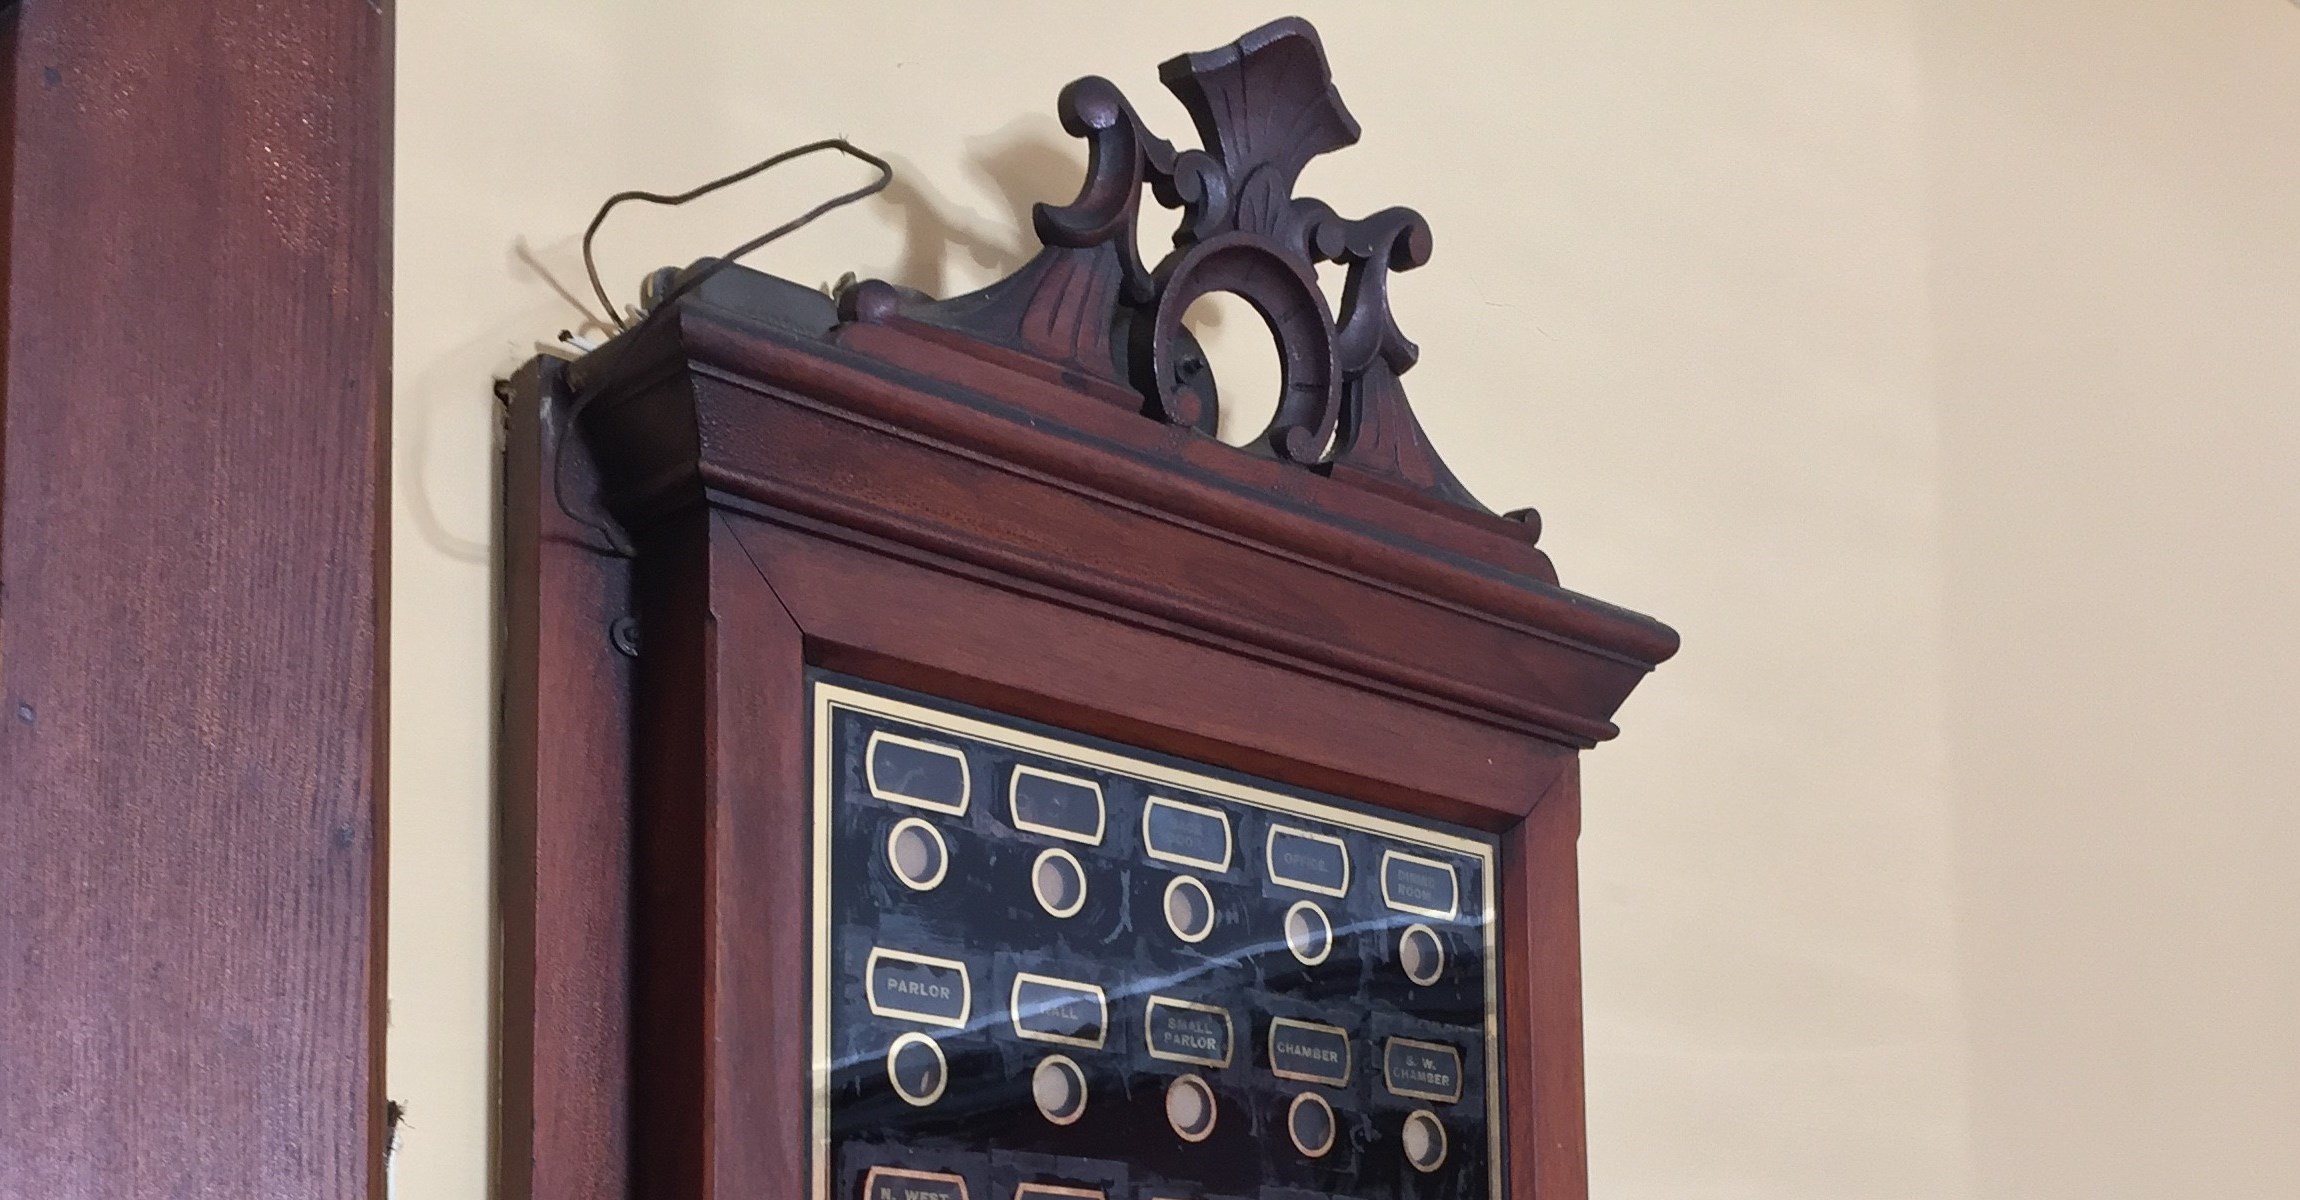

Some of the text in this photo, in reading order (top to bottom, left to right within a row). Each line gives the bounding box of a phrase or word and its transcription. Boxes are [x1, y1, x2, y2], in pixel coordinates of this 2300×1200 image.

[1397, 883, 1432, 902] ROOM
[887, 977, 950, 1000] PARLOR
[1167, 1017, 1213, 1035] SMALL
[1164, 1031, 1217, 1050] PARLOR
[1277, 1041, 1338, 1063] CHAMBER
[1392, 1067, 1450, 1087] CHAMBER
